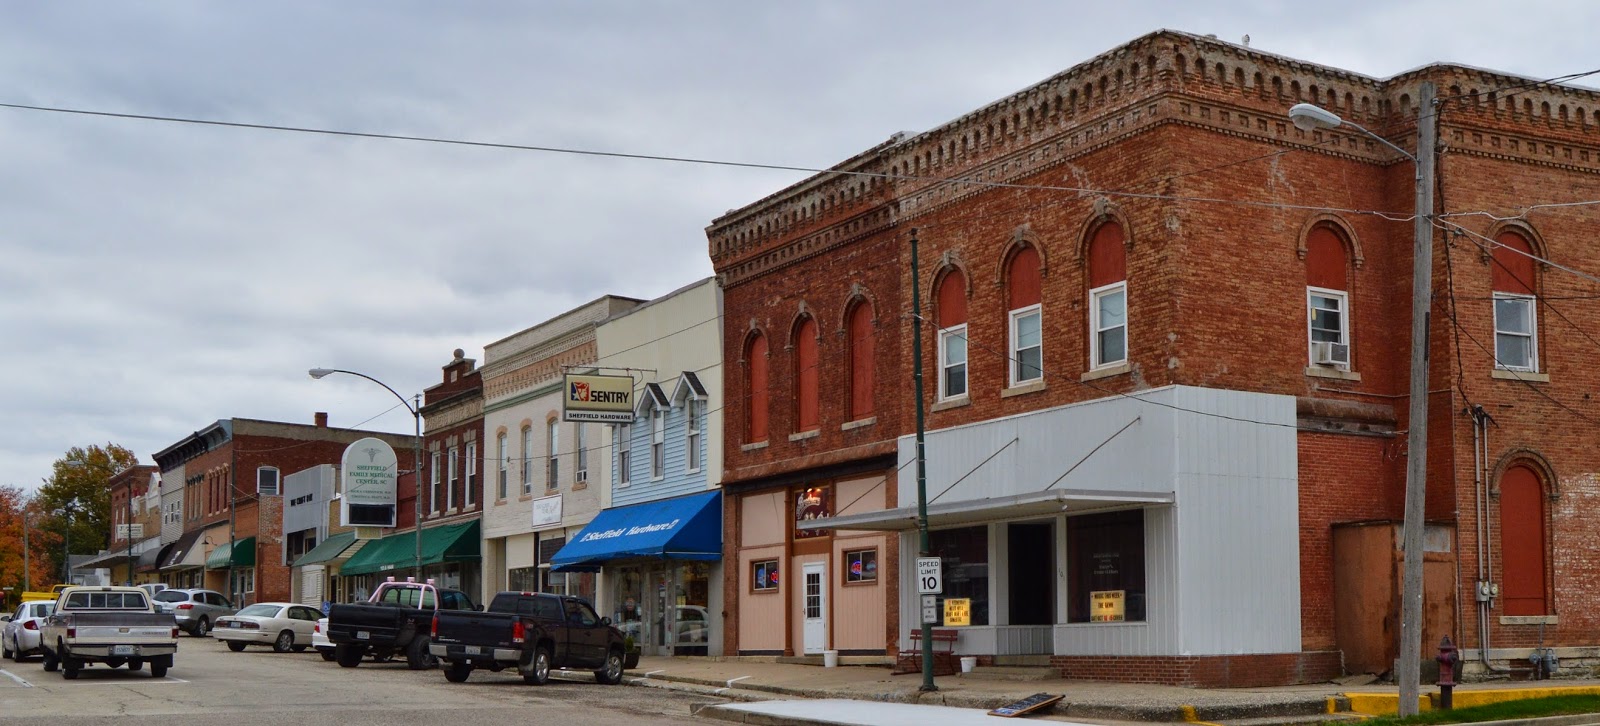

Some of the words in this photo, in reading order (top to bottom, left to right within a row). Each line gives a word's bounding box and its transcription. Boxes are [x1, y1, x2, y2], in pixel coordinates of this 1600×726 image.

[590, 390, 629, 403] SENTRY
[585, 528, 627, 541] Sheffield
[625, 522, 670, 536] Hardware
[922, 576, 937, 590] 10
